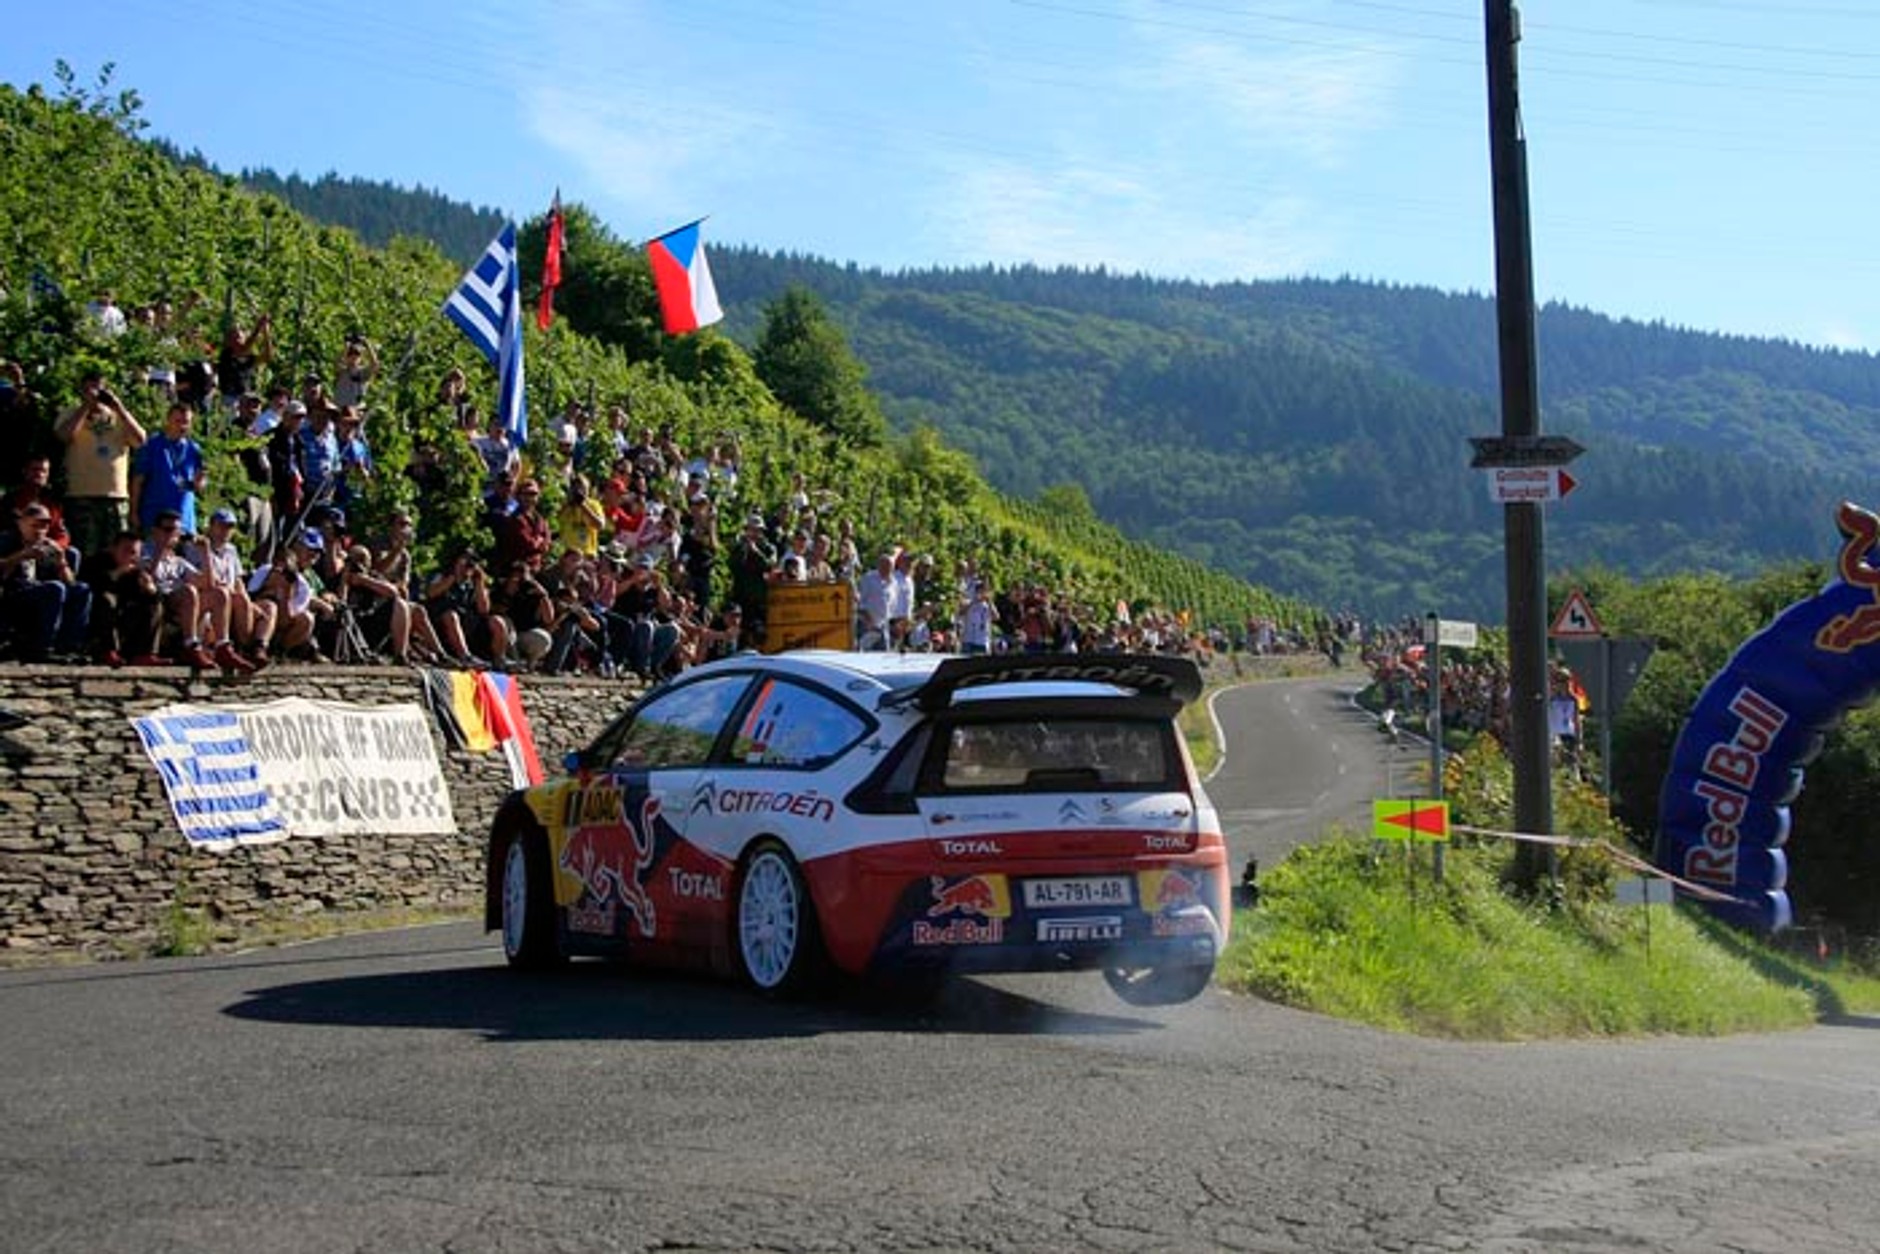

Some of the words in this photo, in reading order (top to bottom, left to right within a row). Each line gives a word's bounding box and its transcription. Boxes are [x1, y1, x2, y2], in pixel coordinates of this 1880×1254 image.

[370, 717, 431, 760] RACING
[1702, 686, 1789, 791] Bull
[319, 777, 402, 822] CLUB
[719, 789, 834, 822] CITROËN
[941, 840, 1003, 855] TOTAL
[1143, 835, 1191, 849] TOTAL
[1684, 778, 1748, 885] Red
[669, 867, 724, 900] TOTAL
[913, 918, 958, 945] Red
[959, 916, 1003, 944] Bull
[1037, 916, 1122, 941] PIRELLI
